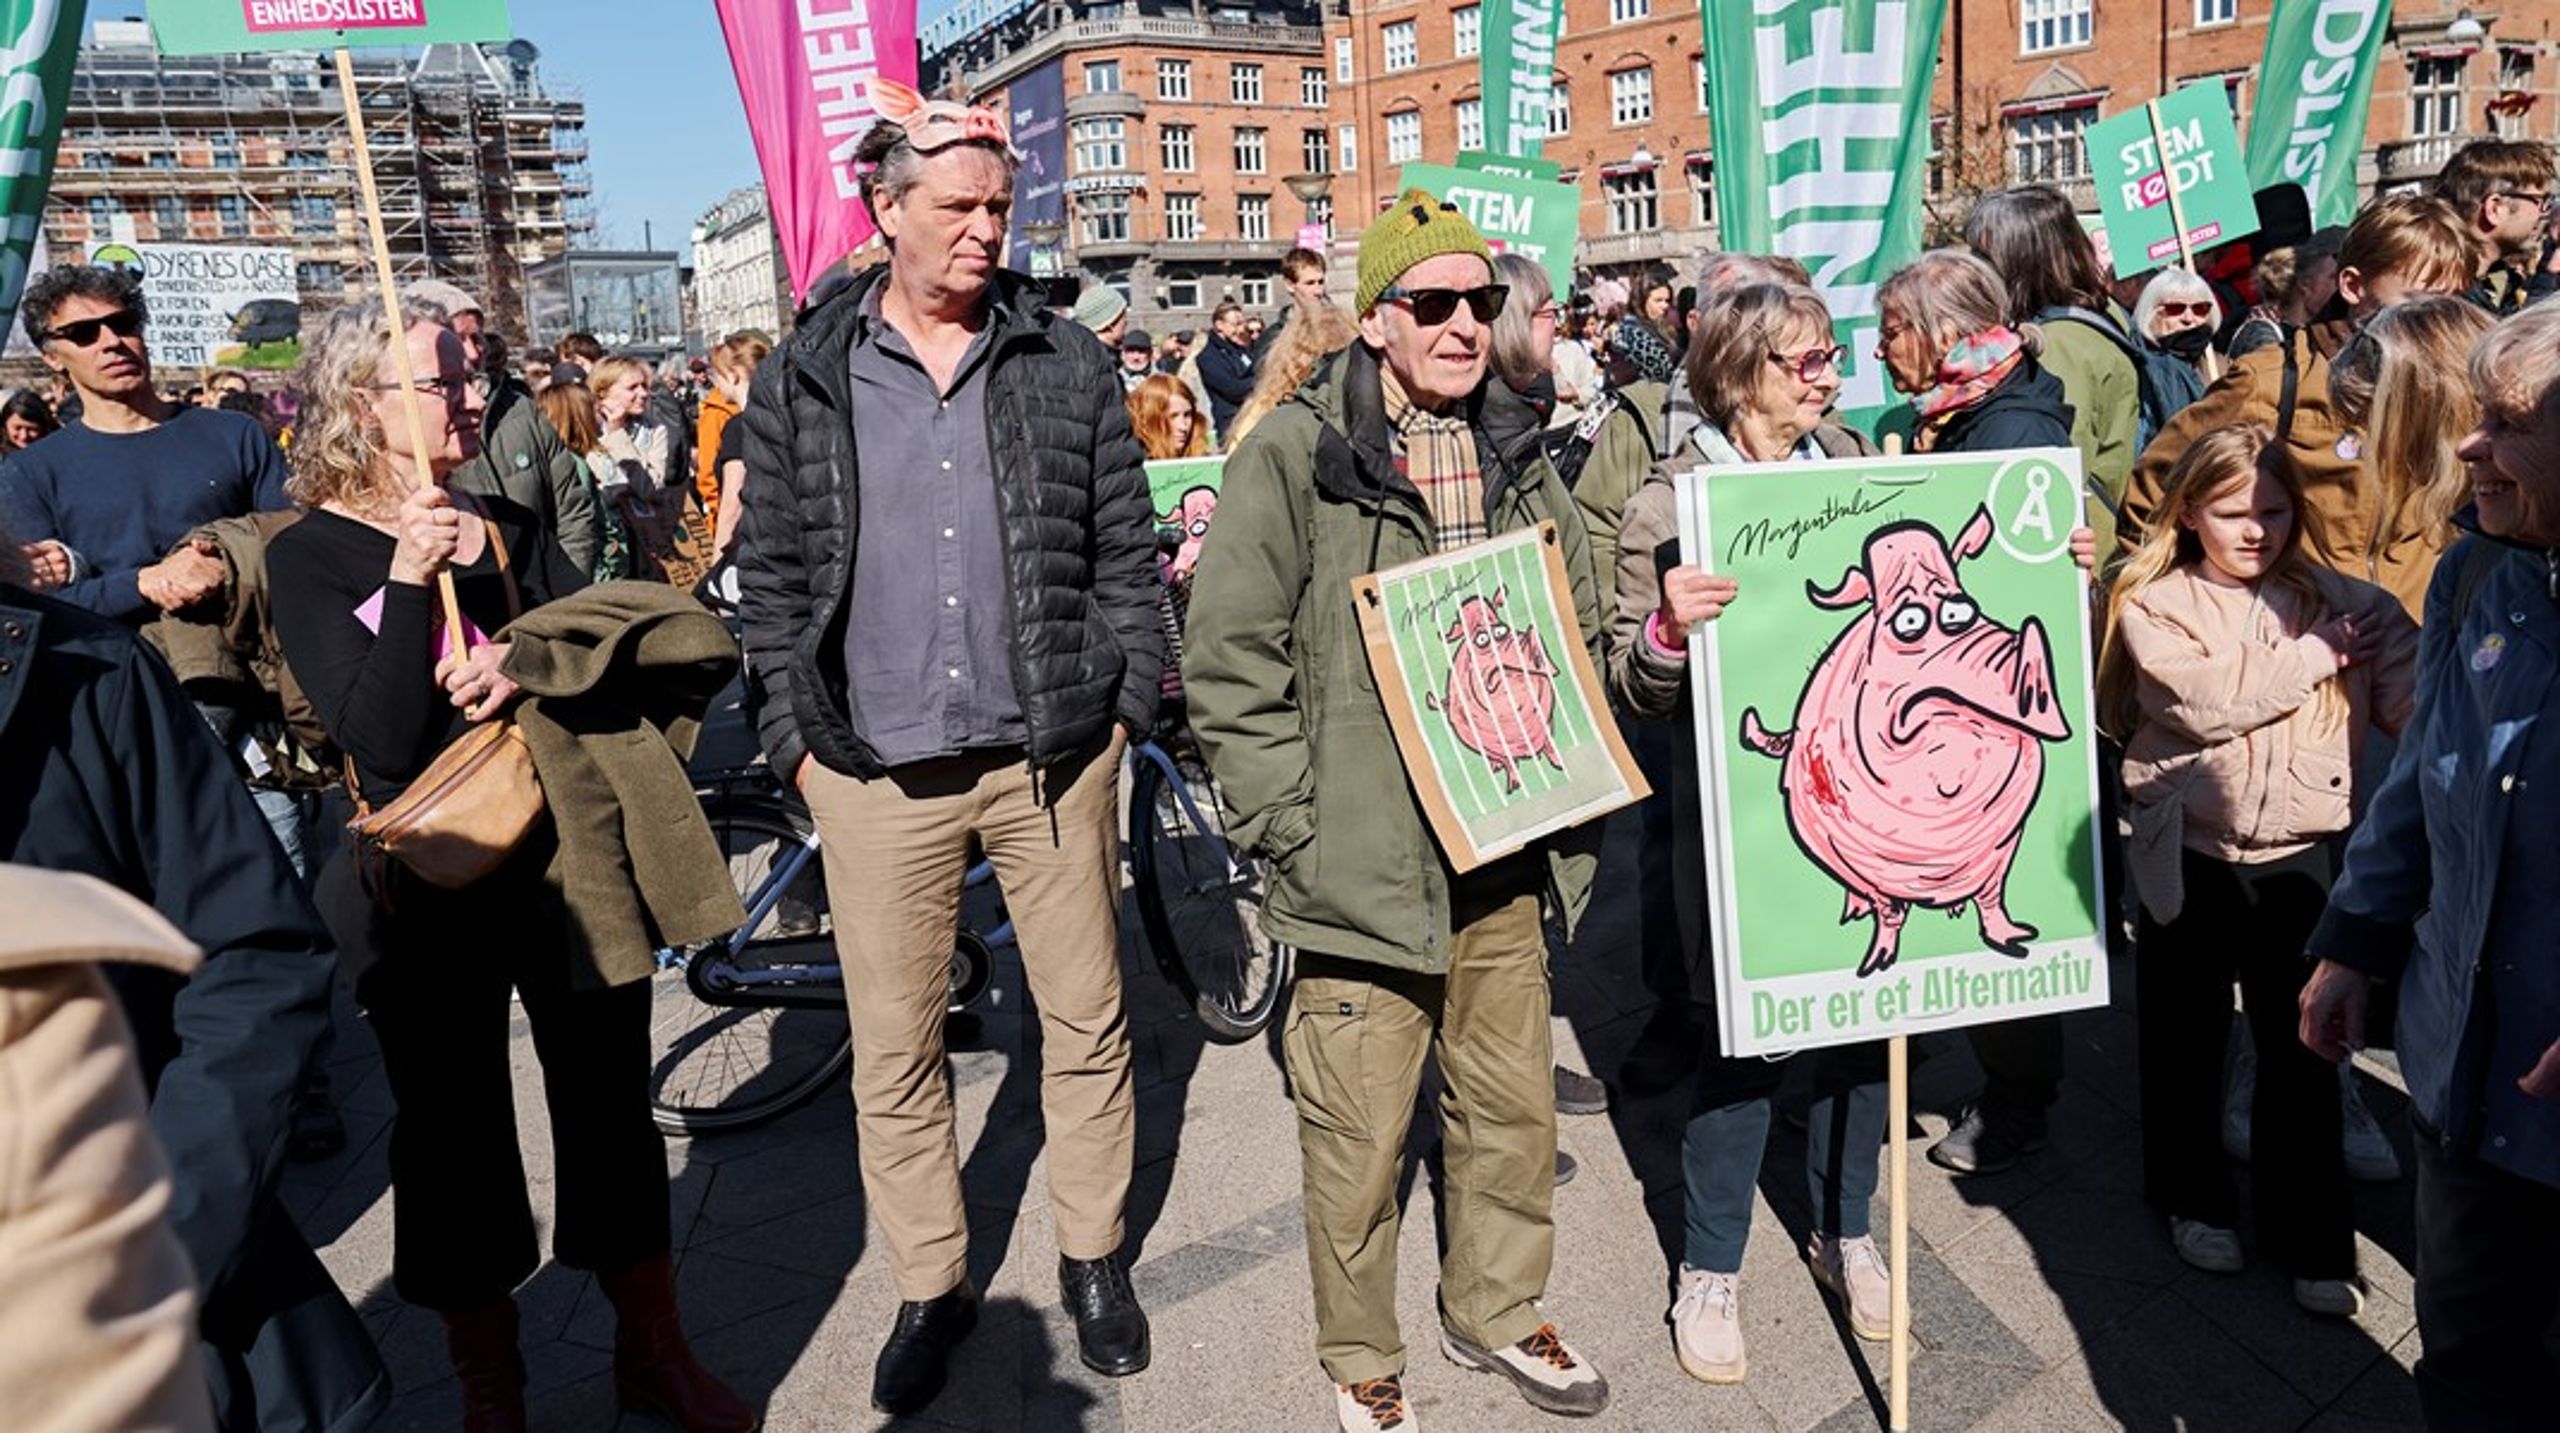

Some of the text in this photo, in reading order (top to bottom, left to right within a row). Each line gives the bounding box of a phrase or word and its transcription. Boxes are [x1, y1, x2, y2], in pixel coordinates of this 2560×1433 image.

[250, 0, 417, 25] ENHEDSLISTEN
[2120, 118, 2205, 177] STEM
[2121, 150, 2215, 212] RØDT
[143, 251, 293, 279] DYRENES OASE
[2010, 465, 2055, 542] Å
[1751, 950, 2093, 1039] Der er et Alternativ
